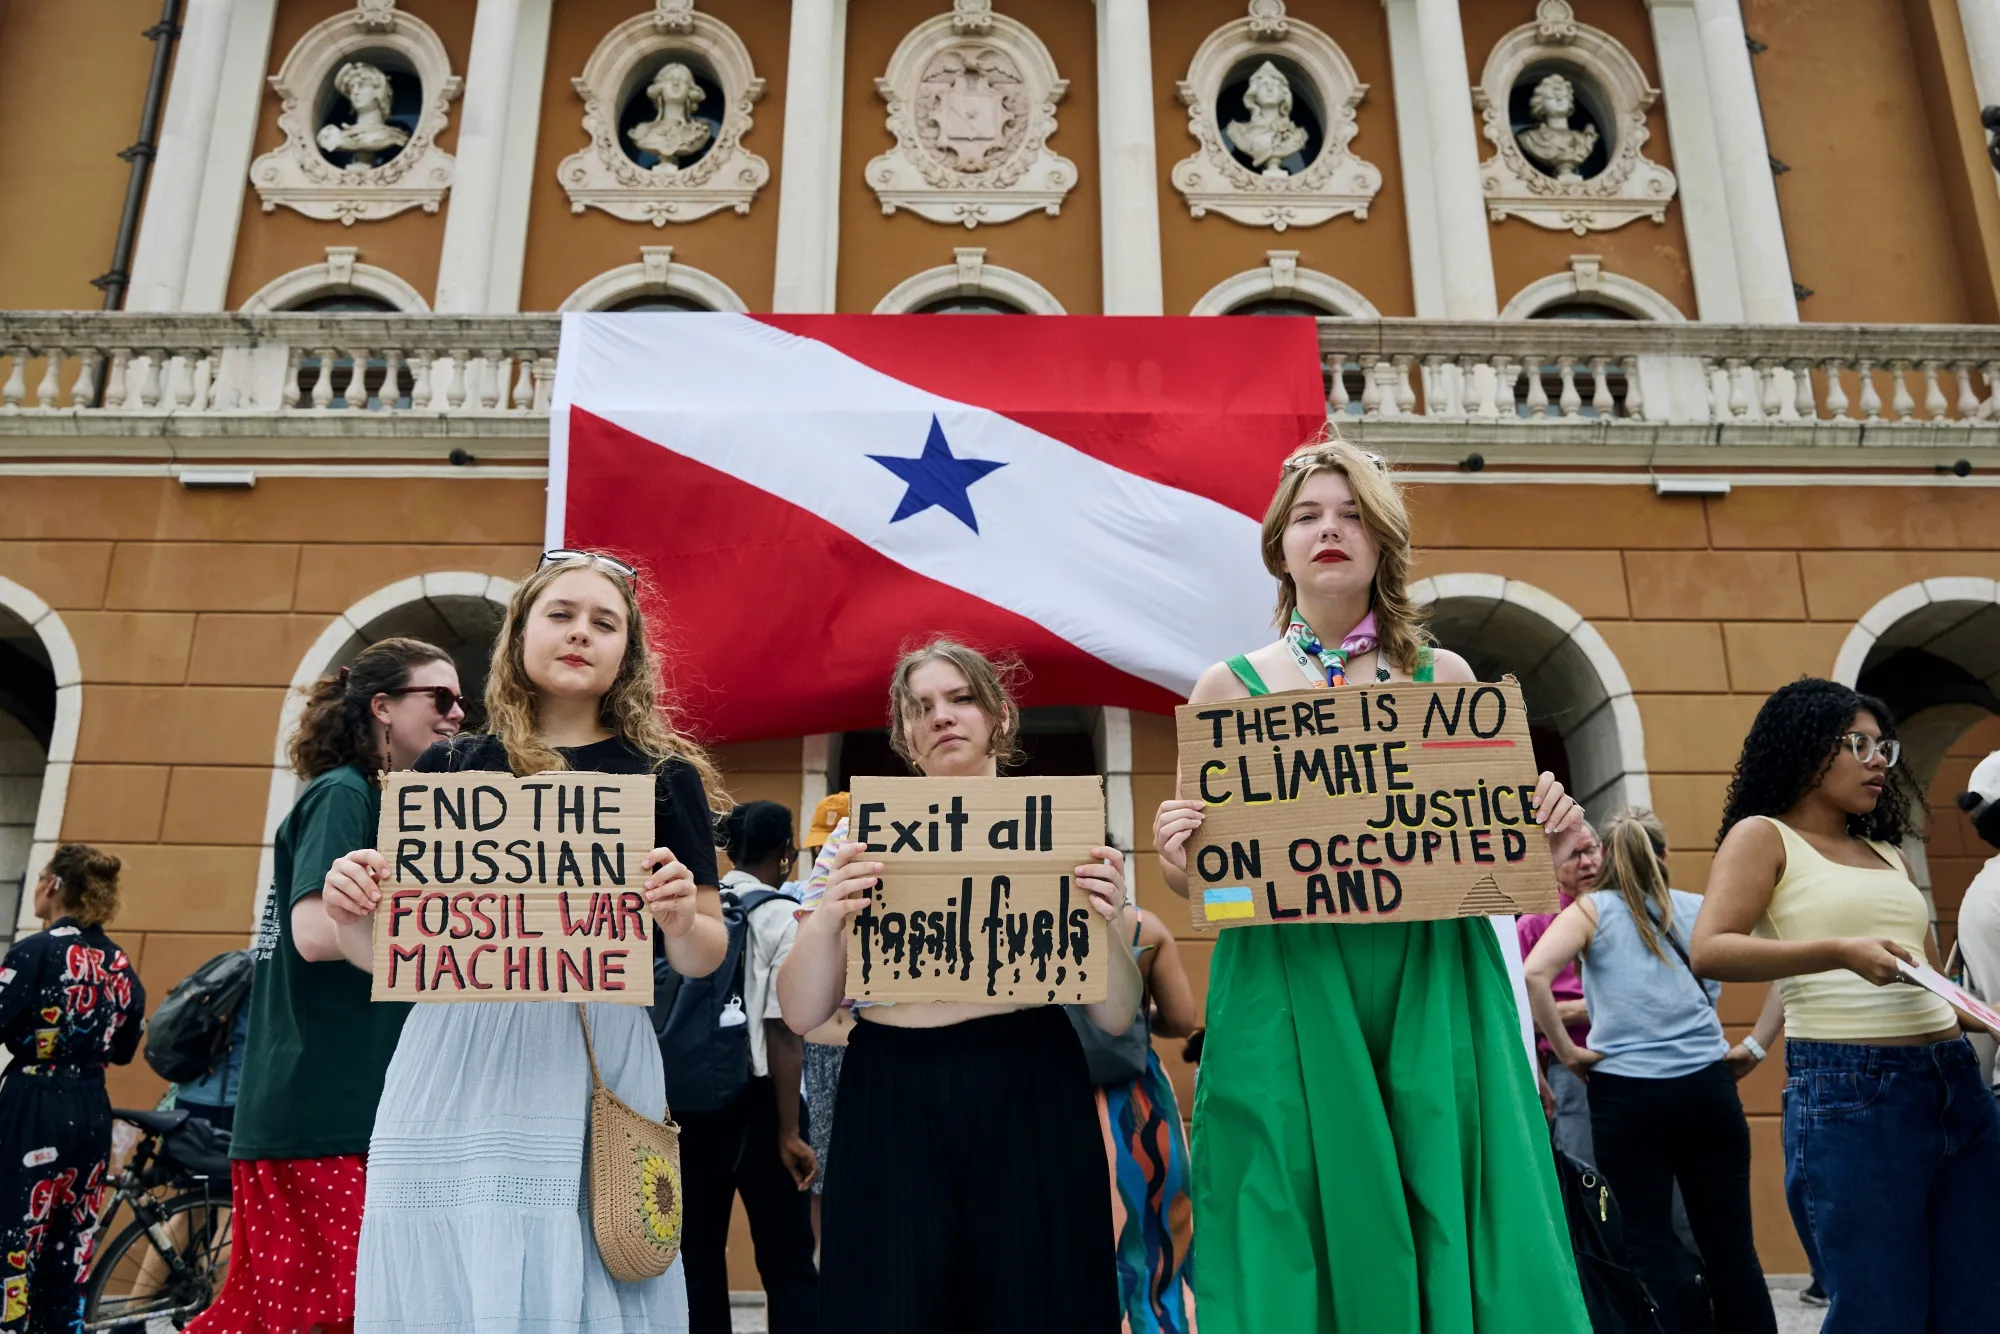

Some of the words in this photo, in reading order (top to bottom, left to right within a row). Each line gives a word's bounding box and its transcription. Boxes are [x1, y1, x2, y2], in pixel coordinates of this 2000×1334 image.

[1196, 698, 1339, 748] THERE
[1422, 686, 1507, 739] NO
[398, 784, 508, 832] END
[521, 783, 621, 834] THE
[857, 796, 969, 853] Exit
[988, 795, 1053, 852] all
[396, 838, 626, 887] RUSSIAN
[1196, 838, 1262, 882] ON
[1288, 829, 1528, 875] OCCUPIED
[388, 890, 544, 939] FOSSIL
[558, 891, 648, 941] WAR
[1266, 869, 1403, 922] LAND
[981, 875, 1089, 996] fuels
[388, 943, 630, 993] MACHINE
